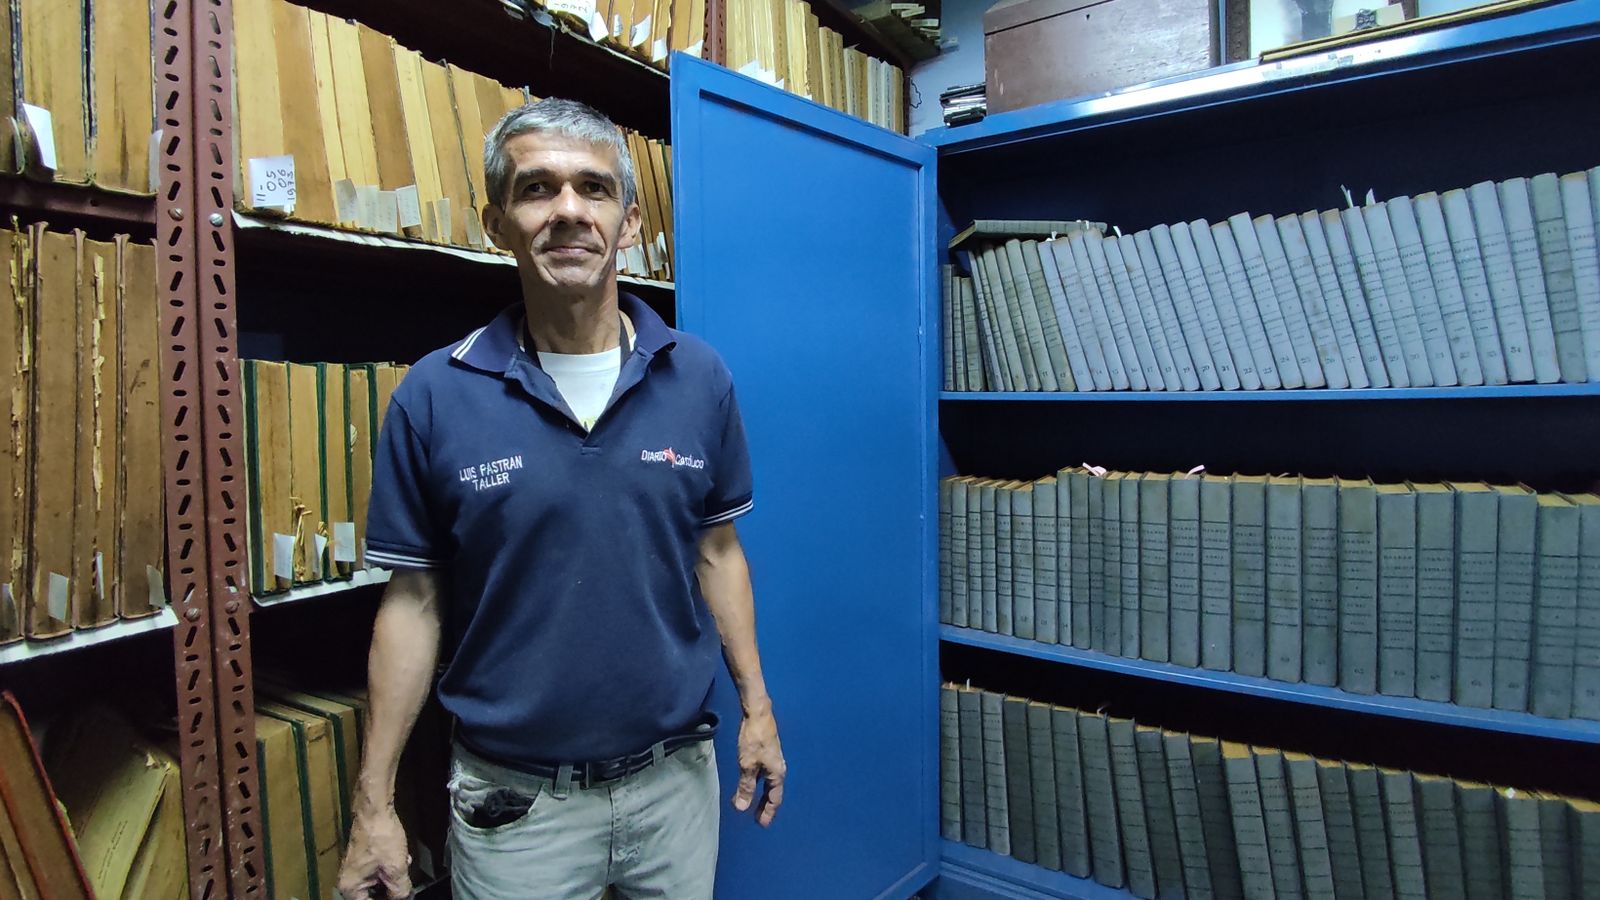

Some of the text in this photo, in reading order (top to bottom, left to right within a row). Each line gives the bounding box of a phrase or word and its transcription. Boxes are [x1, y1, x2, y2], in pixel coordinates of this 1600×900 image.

[266, 171, 277, 192] 05
[277, 168, 287, 188] 06
[641, 449, 667, 464] DIARIO
[459, 466, 478, 482] LUIS
[471, 472, 511, 492] TALLER
